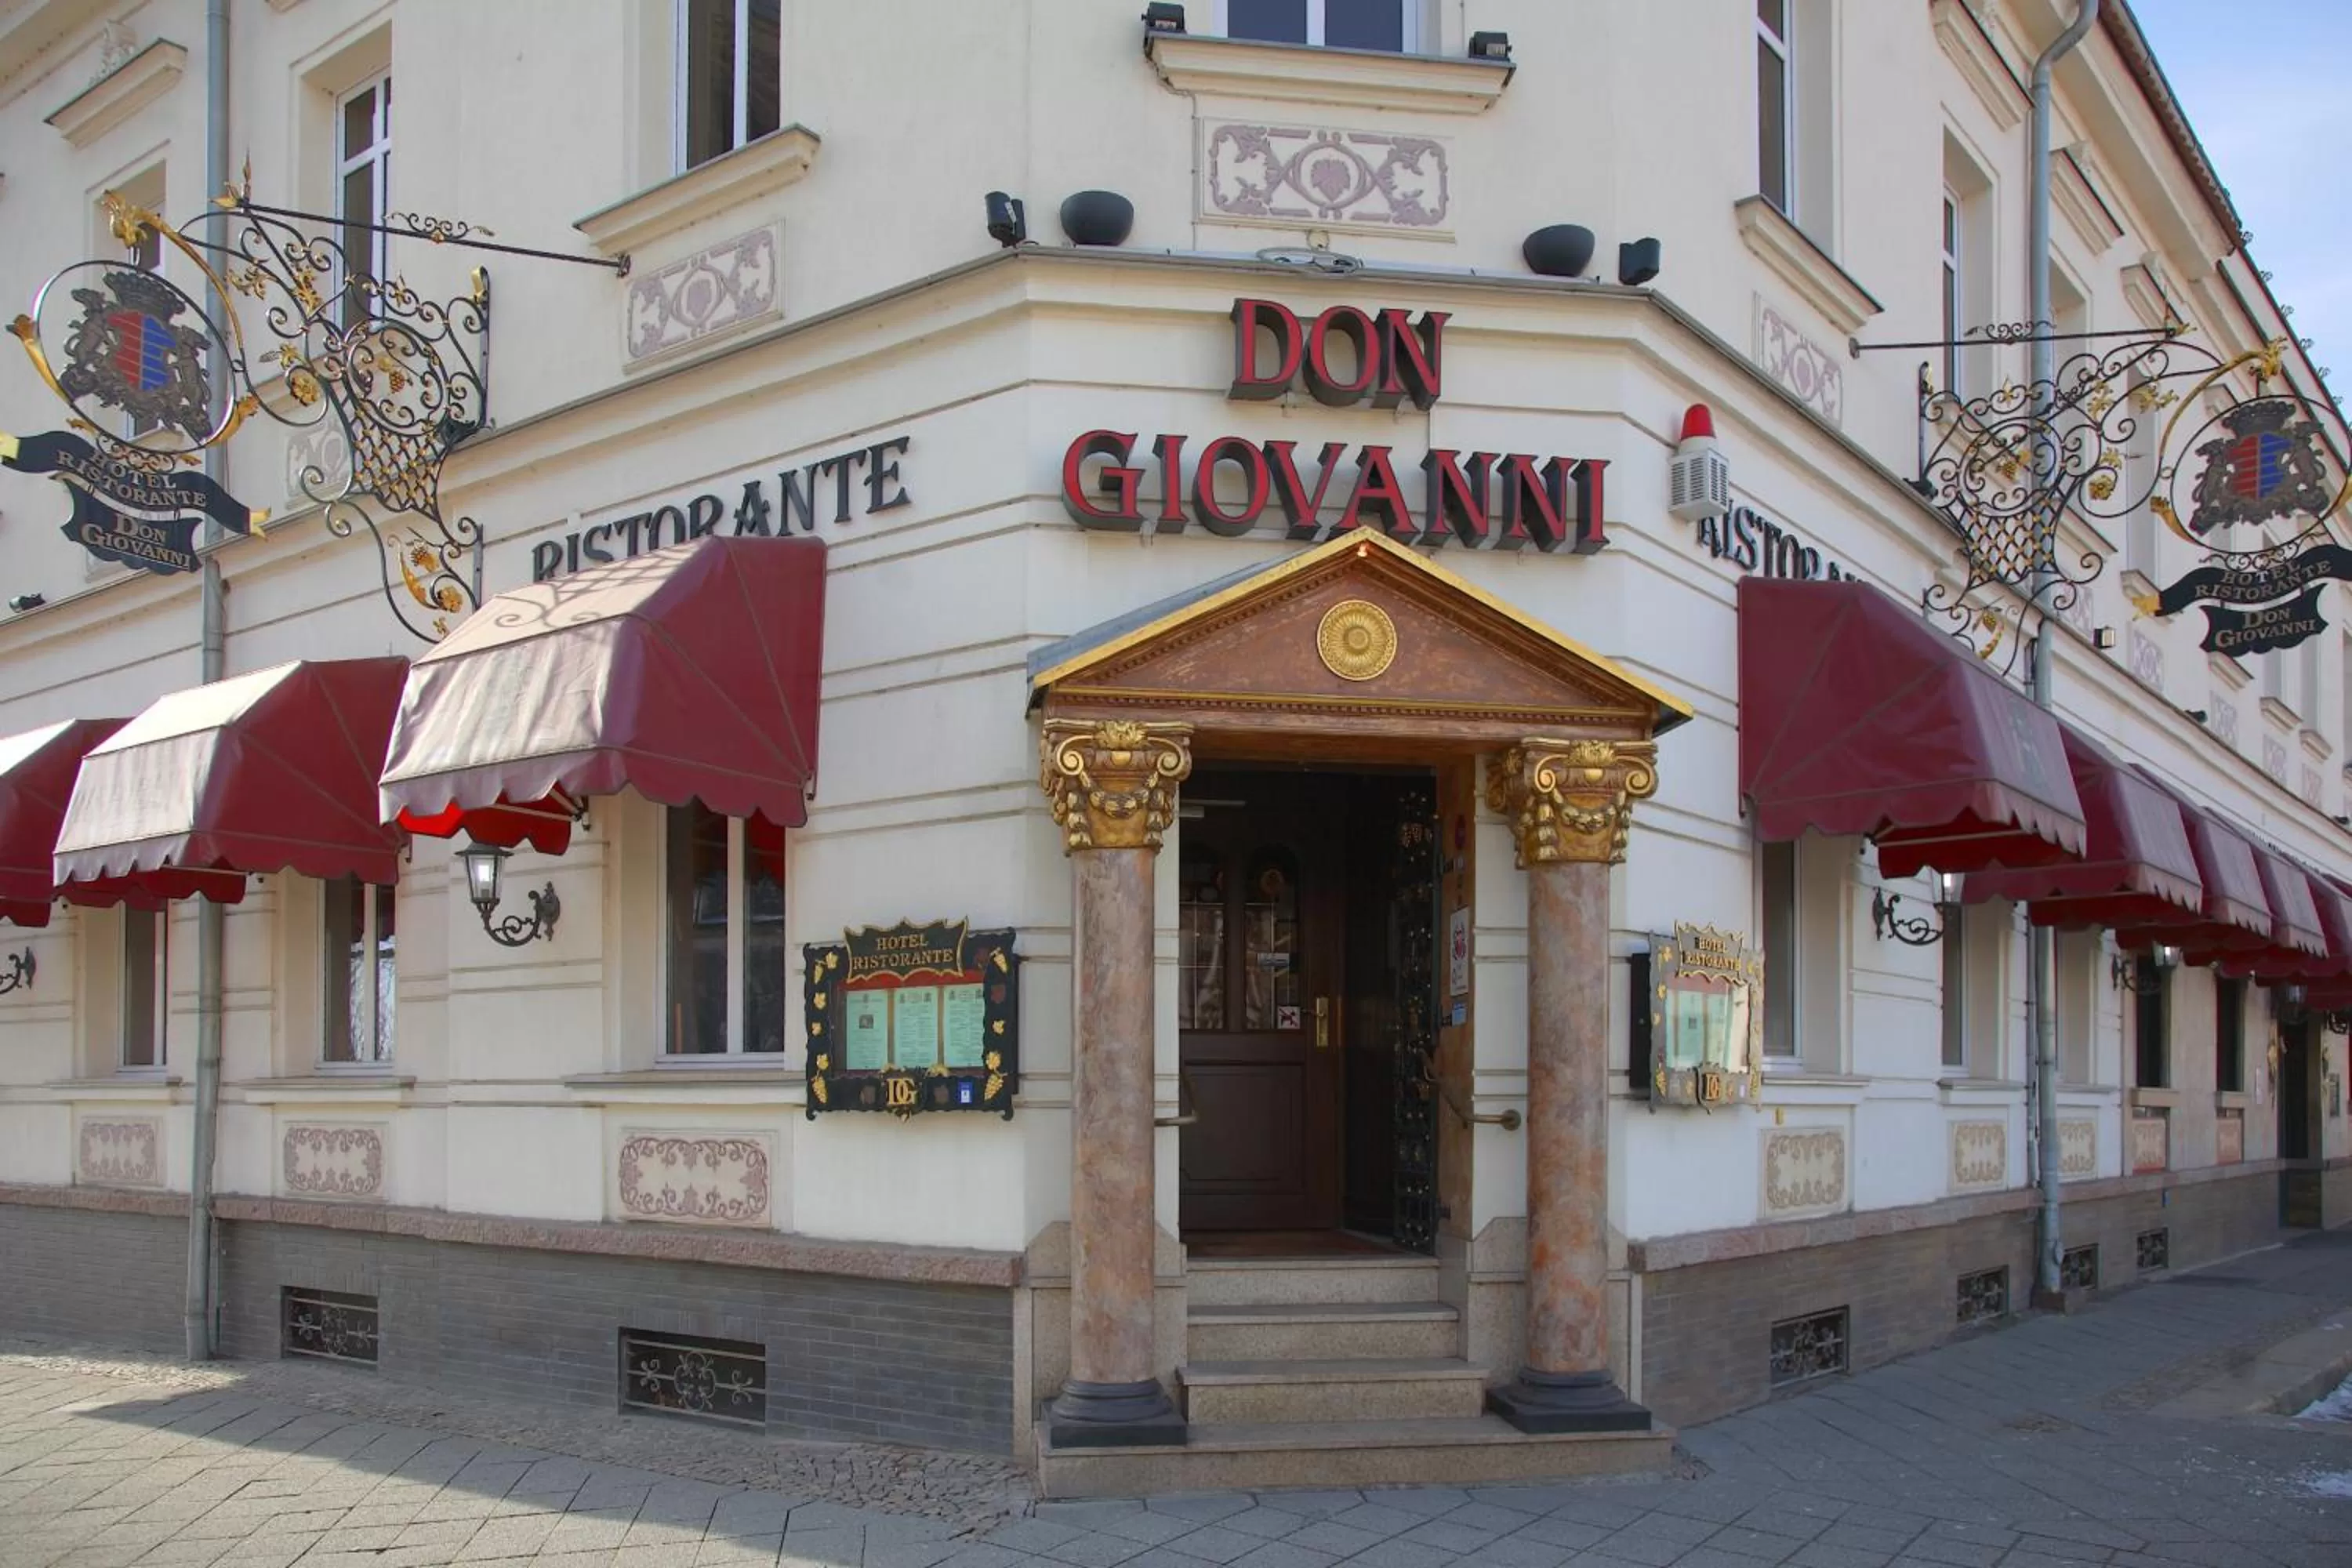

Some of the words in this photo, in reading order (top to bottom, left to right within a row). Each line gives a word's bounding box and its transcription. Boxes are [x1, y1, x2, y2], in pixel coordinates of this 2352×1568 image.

[1228, 297, 1453, 411] DON
[57, 449, 207, 508] RISTORANTE
[90, 449, 176, 489] HOTEL
[1062, 429, 1611, 555] GIOVANNI
[532, 436, 913, 583] RISTORANTE
[81, 523, 192, 567] GIOVANNI
[115, 513, 168, 544] DON
[2195, 560, 2333, 598] RISTORANTE
[2220, 558, 2301, 585] HOTEL
[2215, 619, 2318, 648] GIOVANNI
[2244, 608, 2291, 630] DON
[876, 933, 929, 950] HOTEL
[1697, 936, 1728, 954] HOTEL
[852, 949, 953, 971] RISTORANTE
